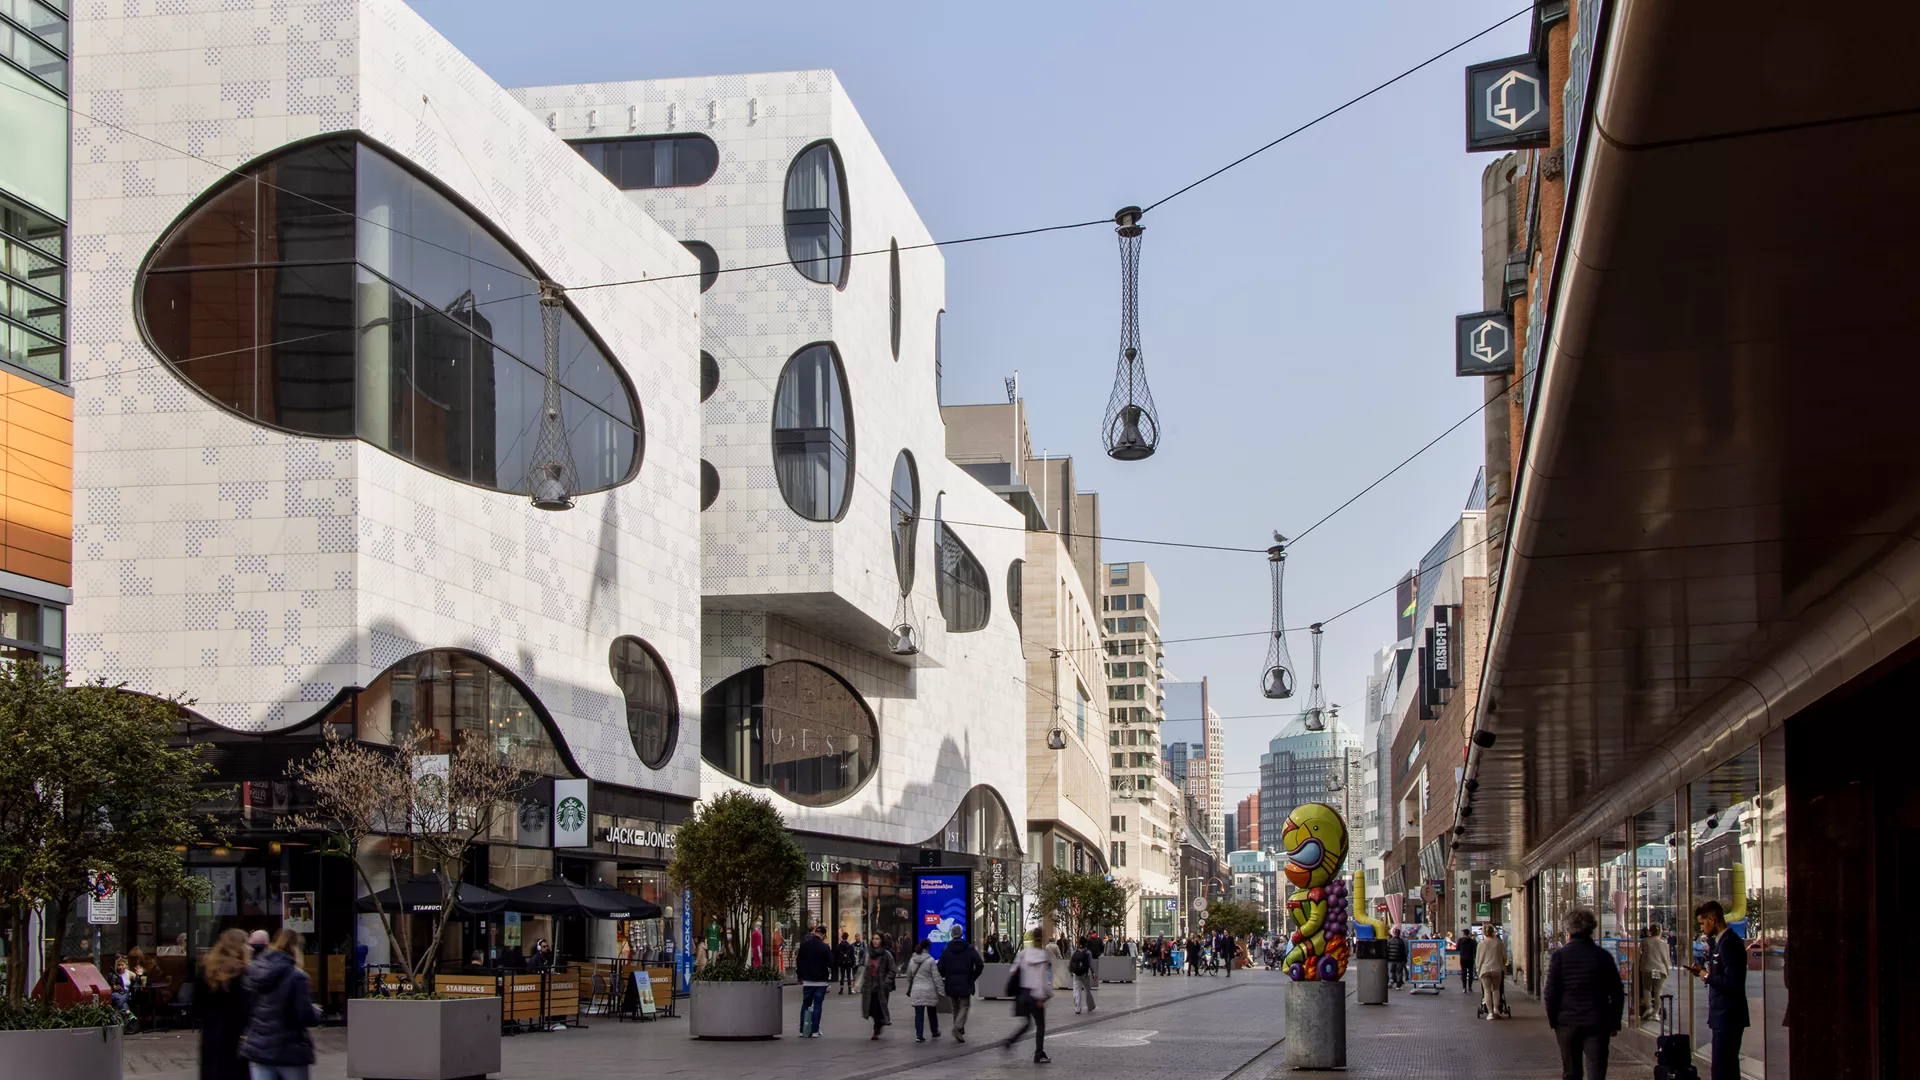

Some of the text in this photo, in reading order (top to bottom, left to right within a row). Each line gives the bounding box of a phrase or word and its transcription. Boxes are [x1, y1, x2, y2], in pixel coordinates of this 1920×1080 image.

[1436, 622, 1447, 671] BASIC-FIT
[606, 827, 676, 849] JACK JONES
[810, 861, 840, 873] COSTES
[1460, 877, 1468, 924] MARK
[446, 985, 485, 993] STARBUCKS
